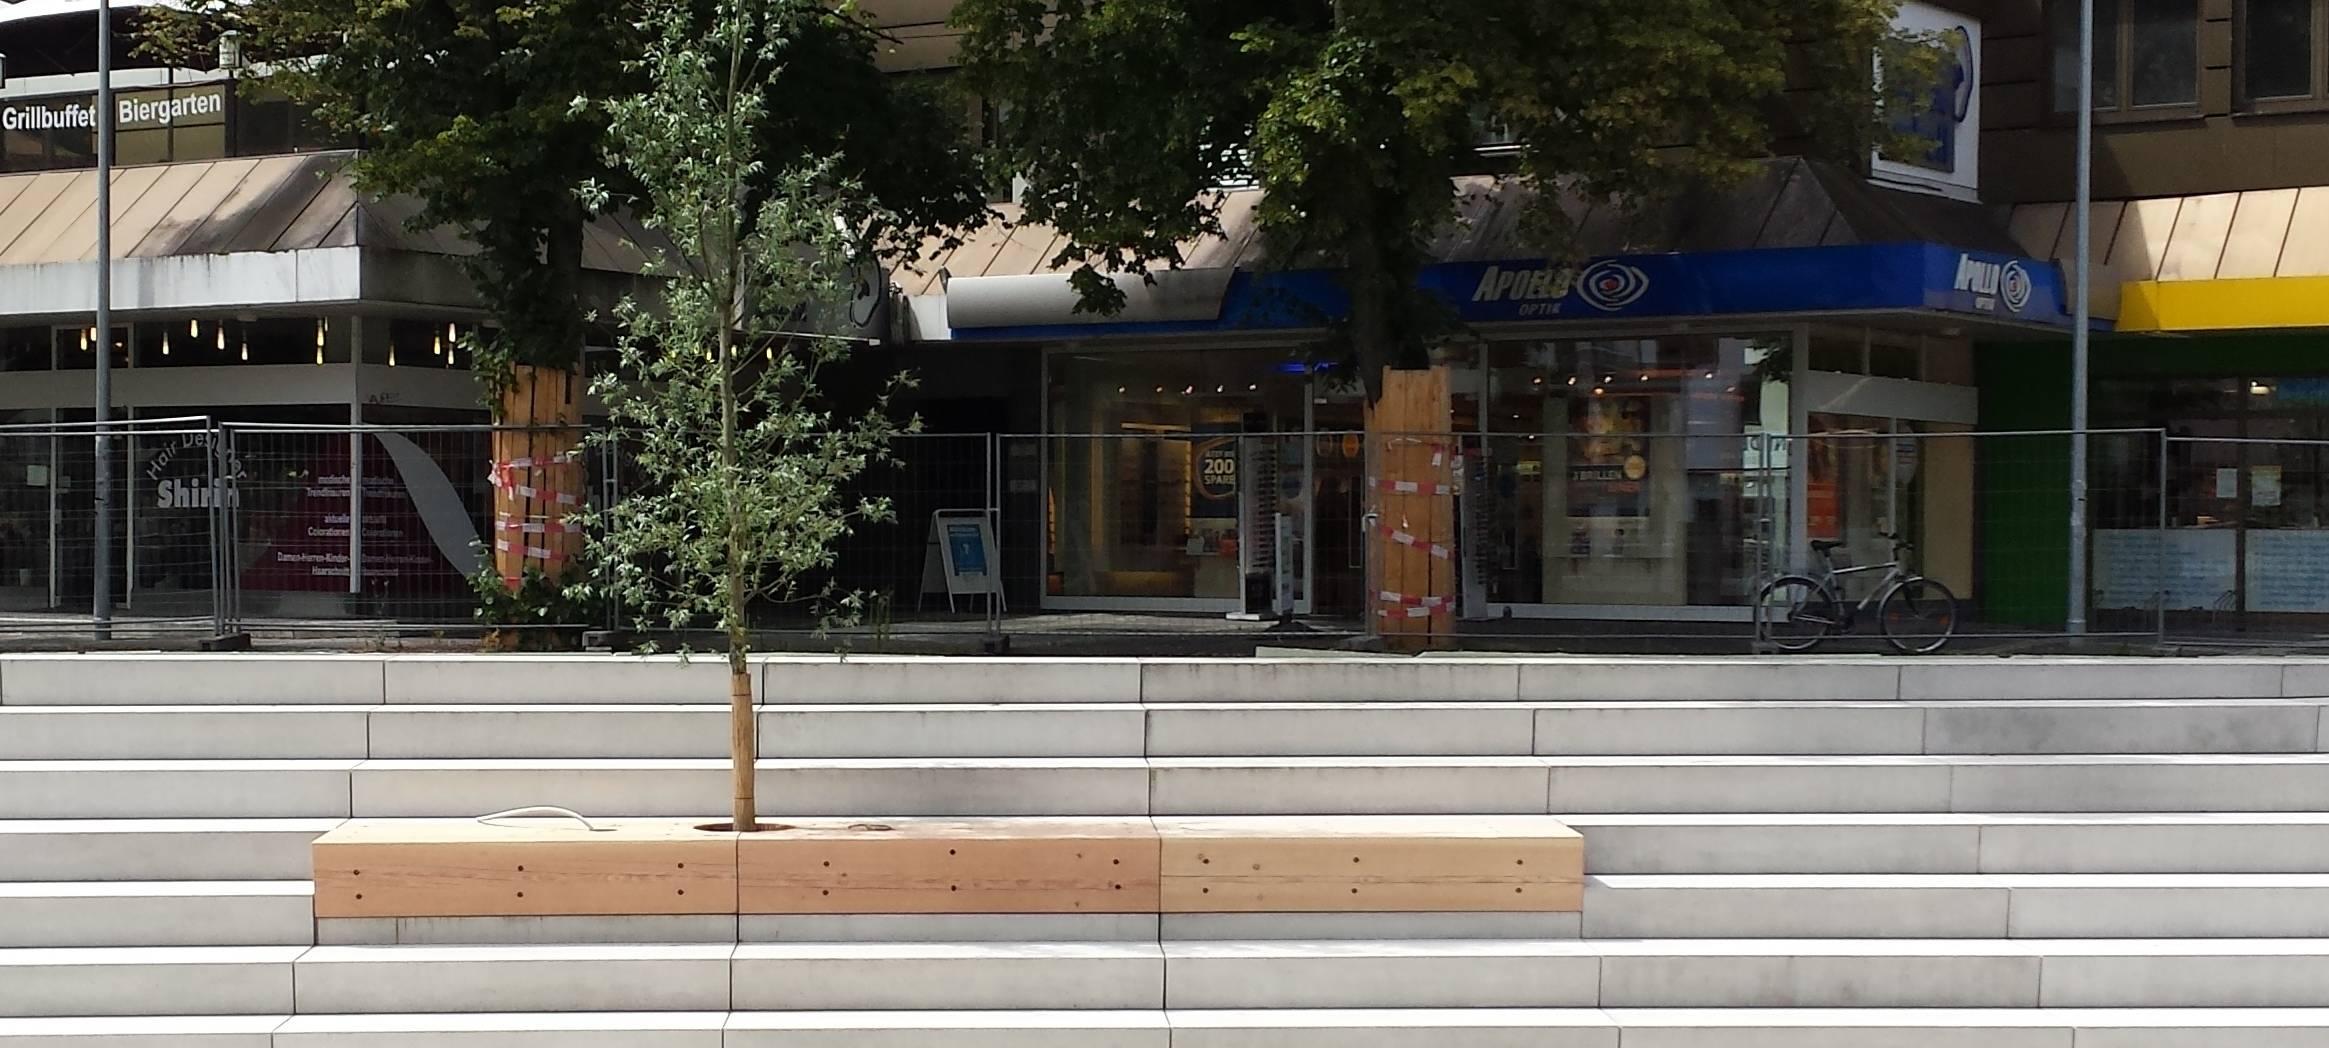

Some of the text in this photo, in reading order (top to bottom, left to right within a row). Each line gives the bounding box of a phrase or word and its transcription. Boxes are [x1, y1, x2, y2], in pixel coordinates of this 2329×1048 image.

[2, 93, 220, 130] Grillbuffet Biergarten
[146, 441, 176, 480] Hair
[1204, 458, 1234, 474] 200
